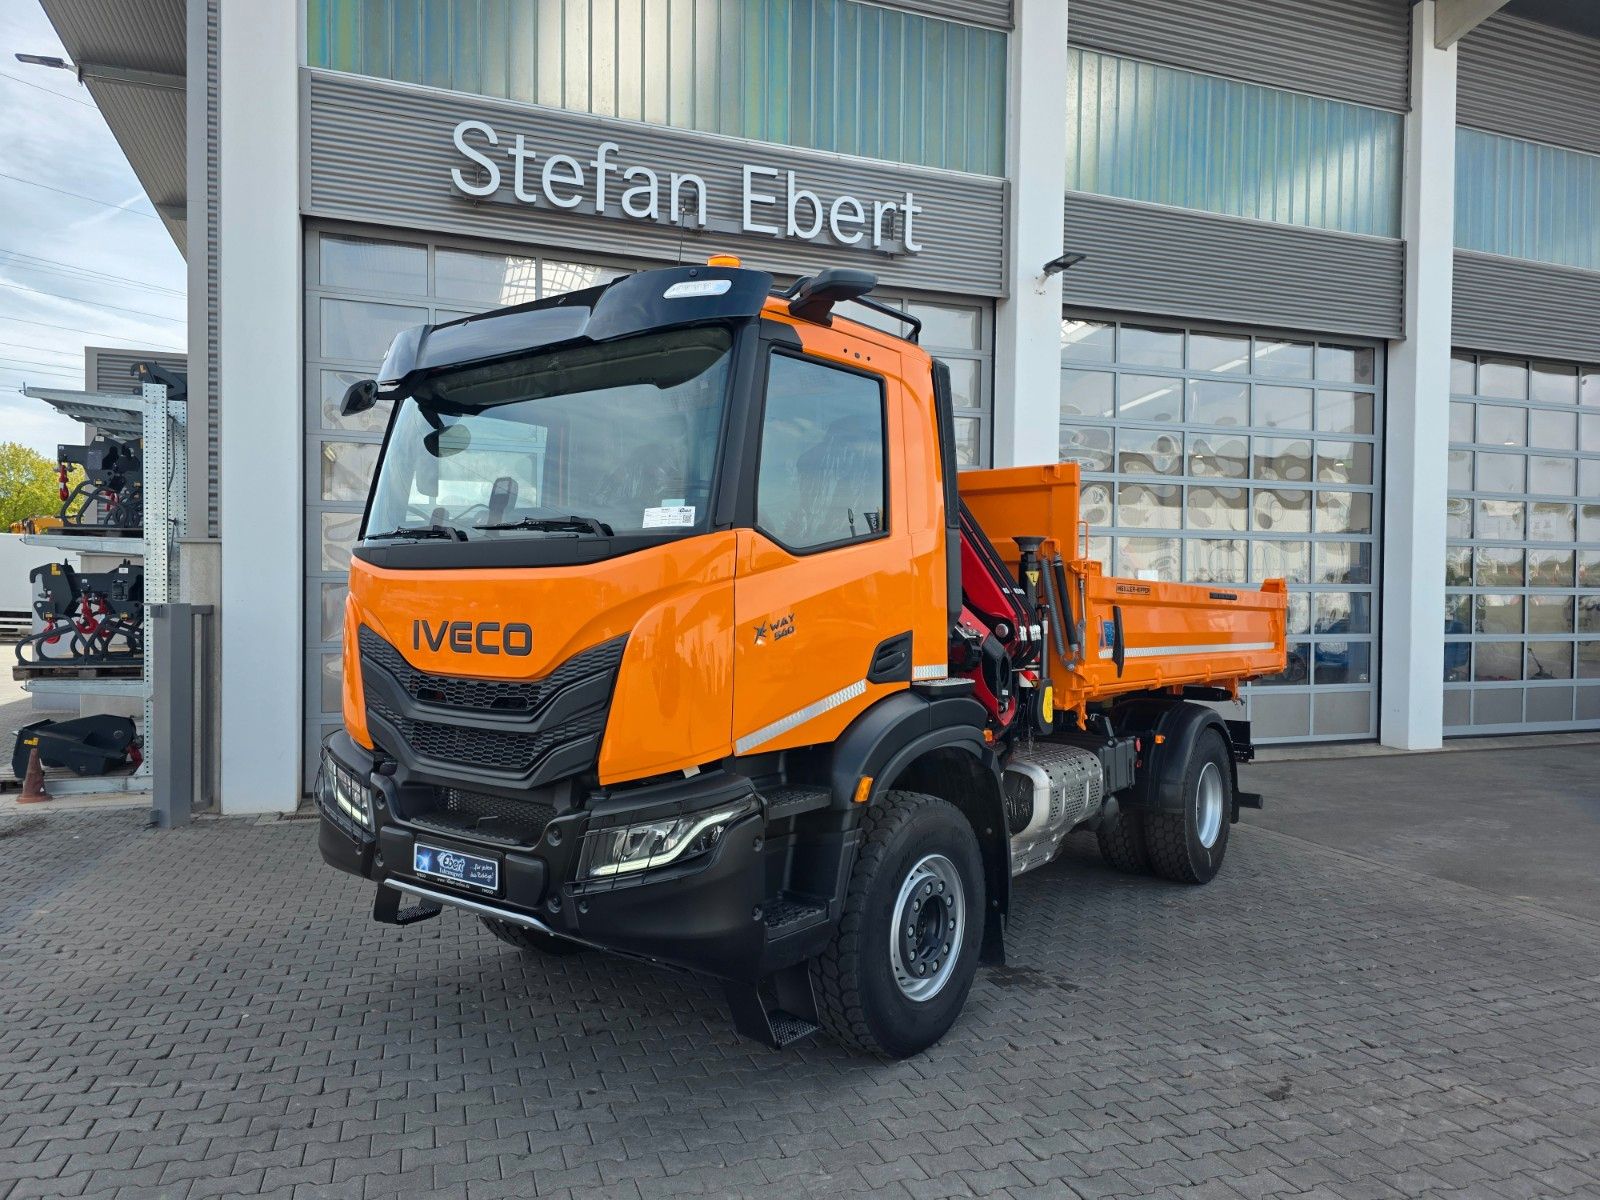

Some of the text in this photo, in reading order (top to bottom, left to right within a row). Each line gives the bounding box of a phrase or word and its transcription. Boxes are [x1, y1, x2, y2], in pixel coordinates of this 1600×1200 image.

[450, 120, 923, 253] Stefan Ebert
[413, 619, 533, 656] IVECO
